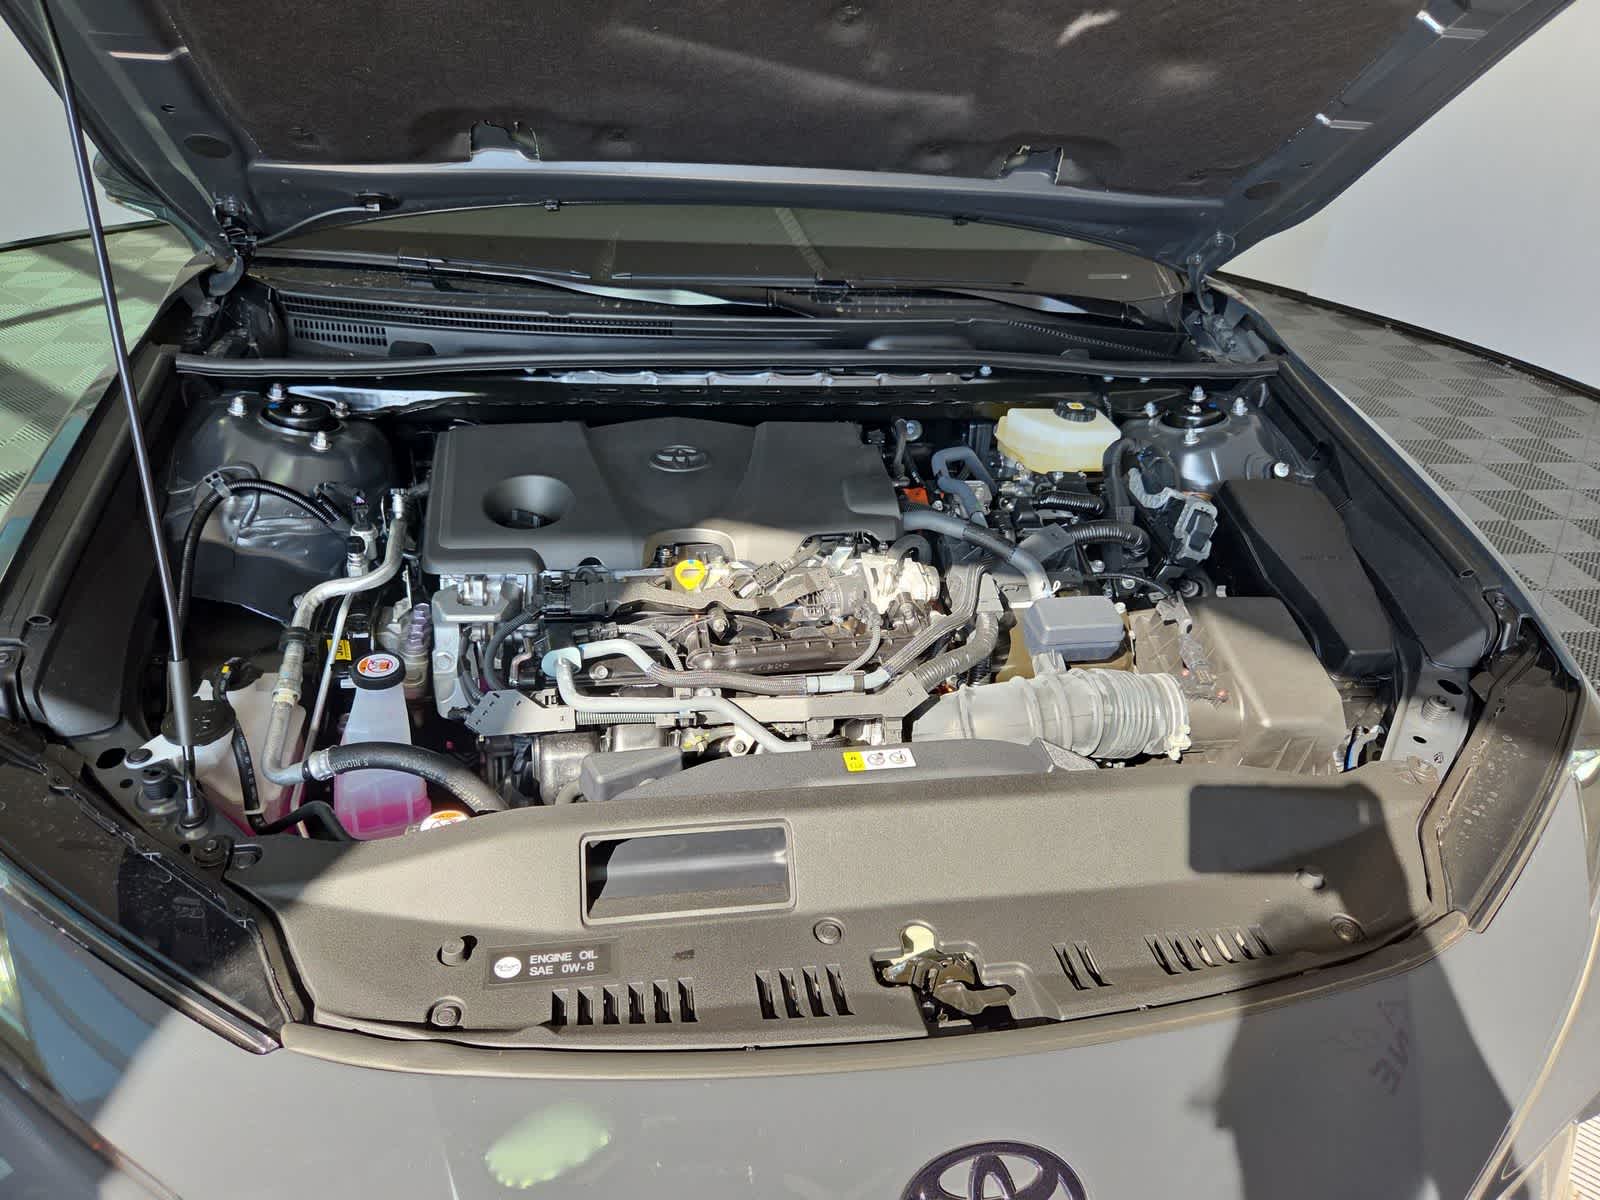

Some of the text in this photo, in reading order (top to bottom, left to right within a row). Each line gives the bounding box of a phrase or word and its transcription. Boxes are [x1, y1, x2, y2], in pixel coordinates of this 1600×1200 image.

[529, 950, 598, 964] ENGINE OIL
[529, 965, 554, 976] SAE
[562, 962, 595, 973] 0W-8
